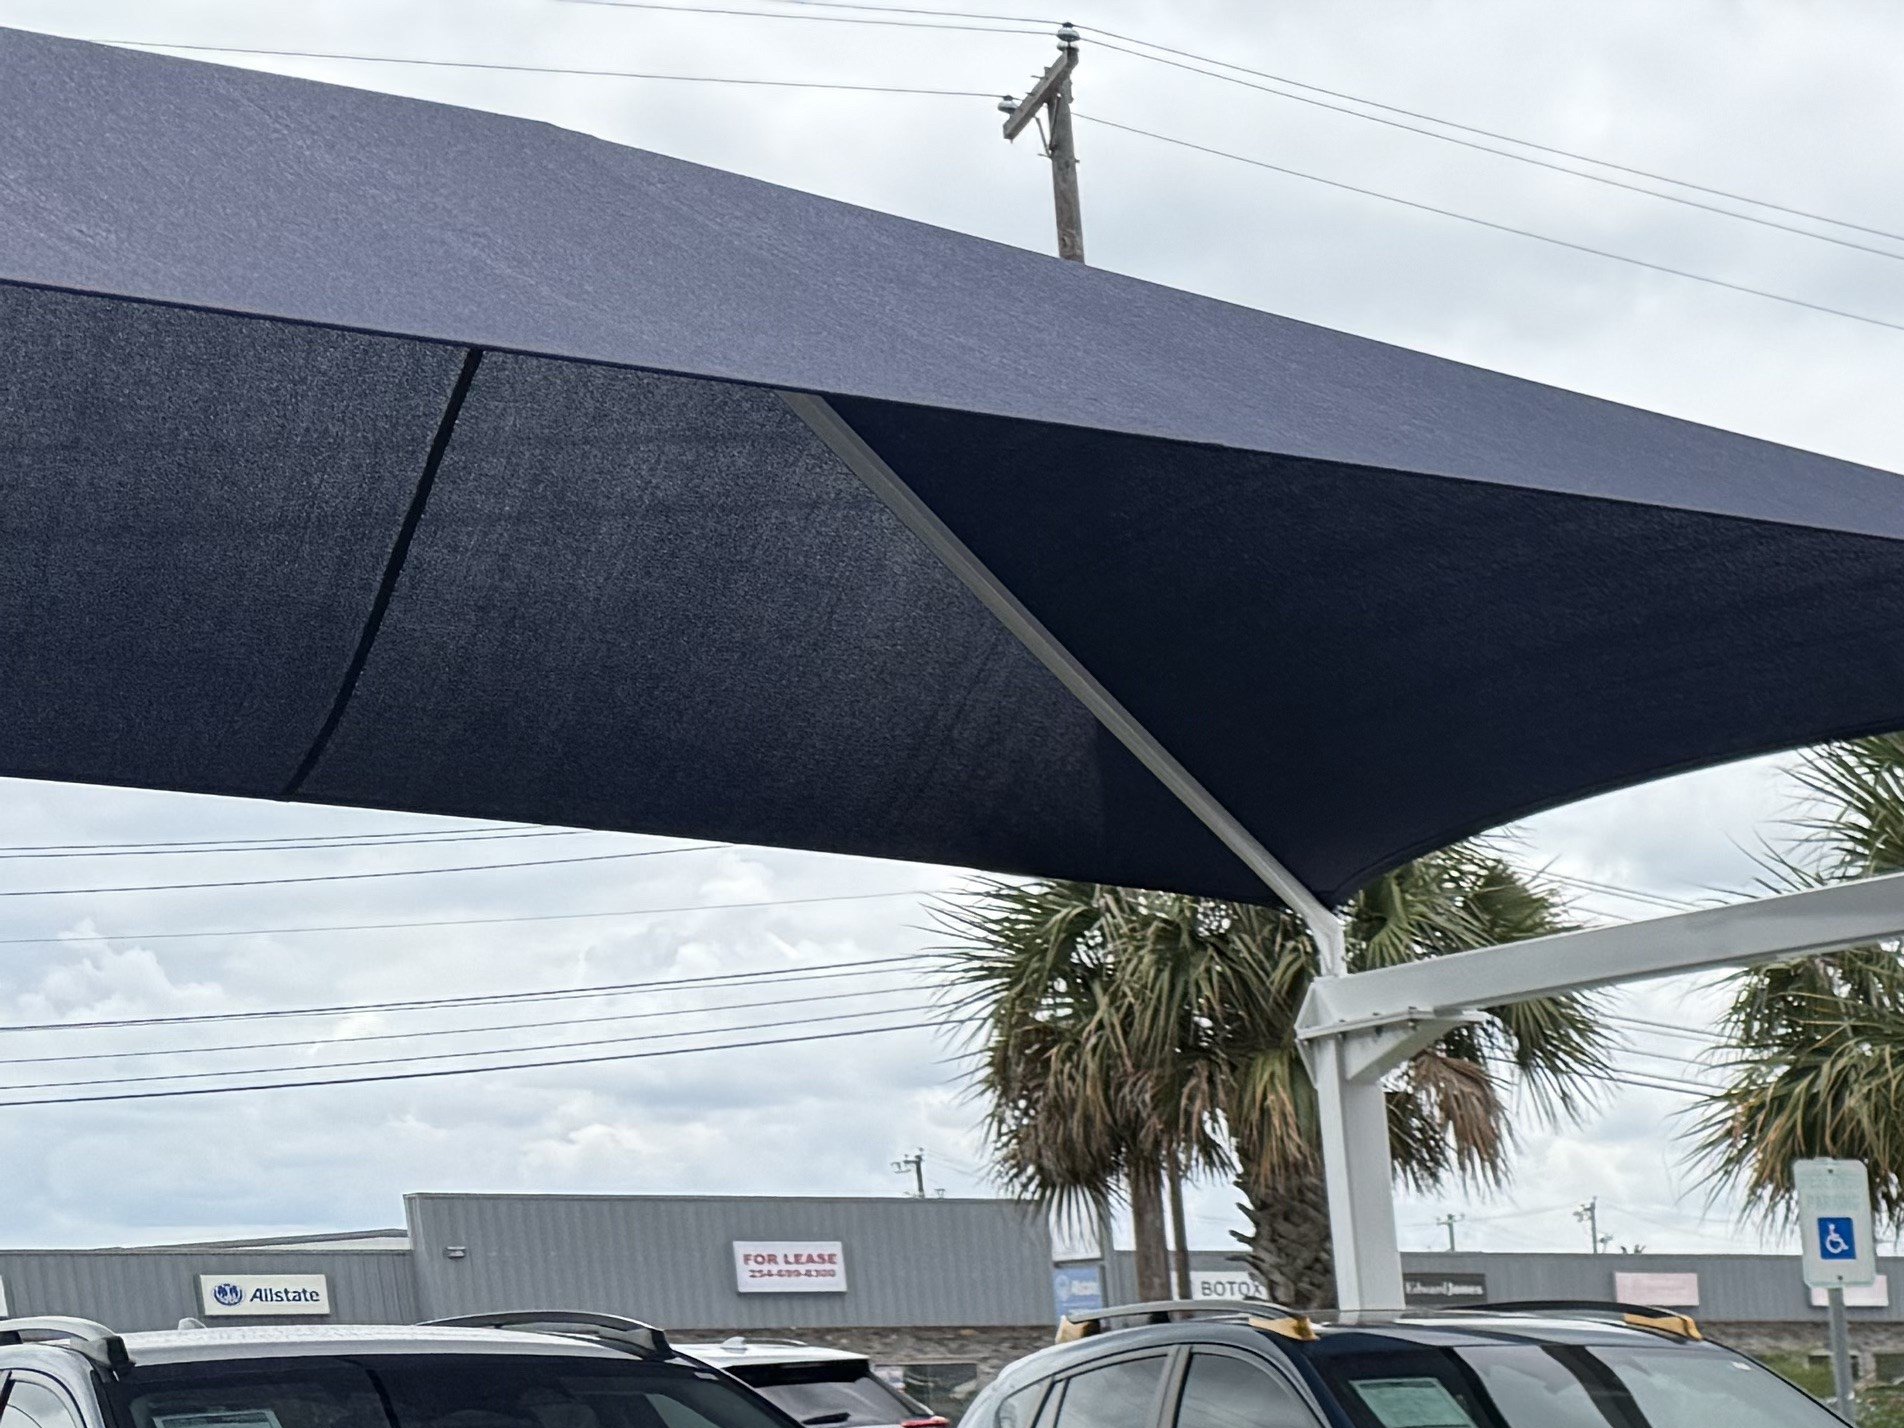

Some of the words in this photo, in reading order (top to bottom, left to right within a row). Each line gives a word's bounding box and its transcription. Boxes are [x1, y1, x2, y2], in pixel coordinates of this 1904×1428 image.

[743, 1254, 779, 1265] FOR
[783, 1253, 837, 1265] LEASE
[250, 1287, 320, 1303] Allstate
